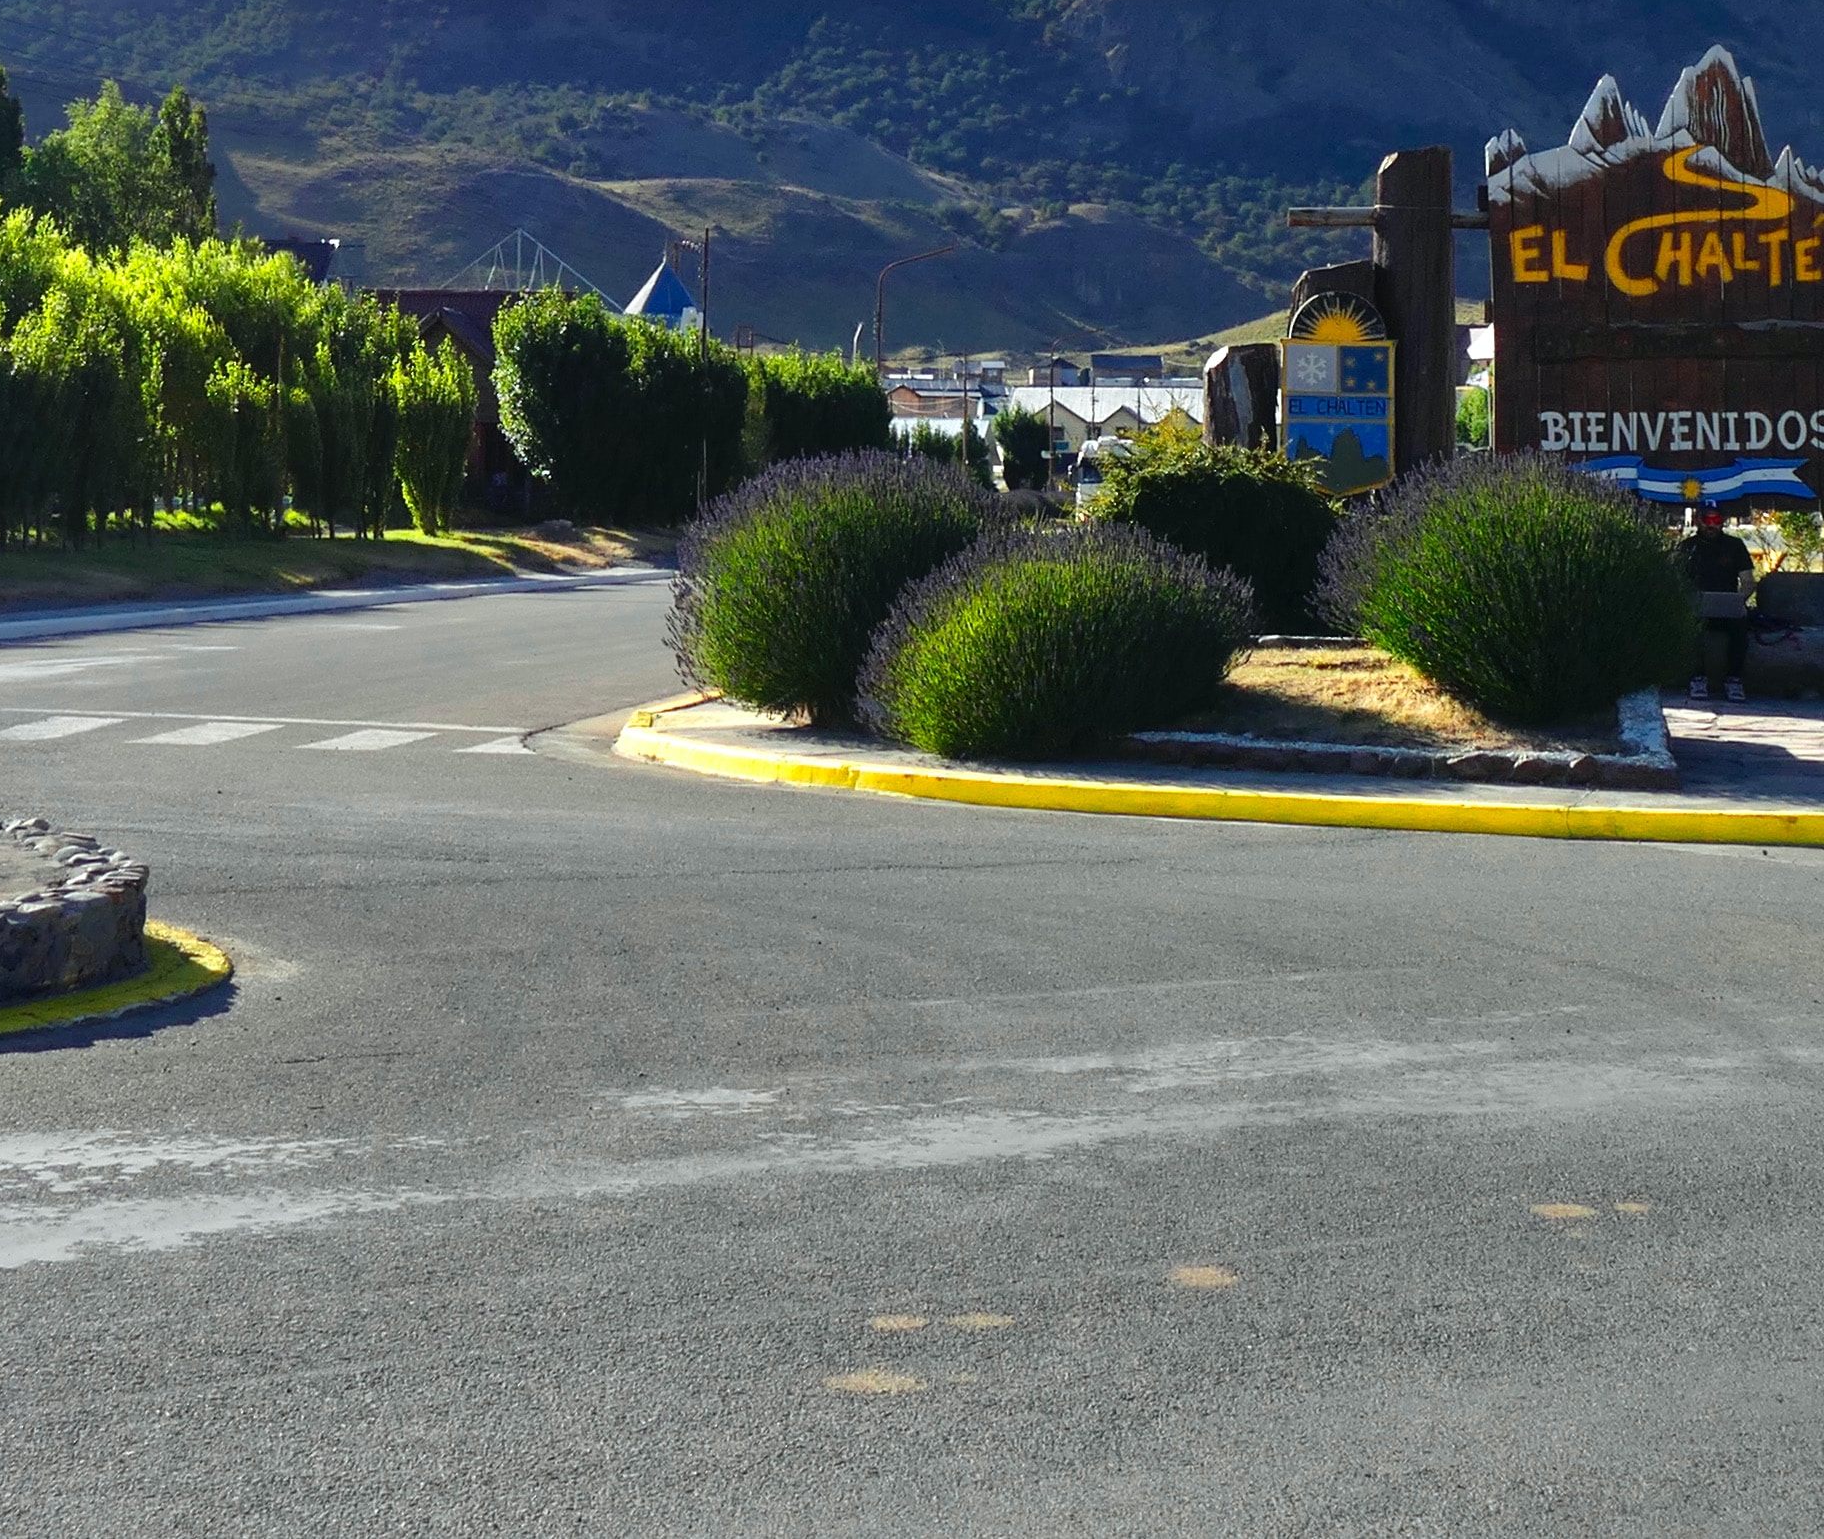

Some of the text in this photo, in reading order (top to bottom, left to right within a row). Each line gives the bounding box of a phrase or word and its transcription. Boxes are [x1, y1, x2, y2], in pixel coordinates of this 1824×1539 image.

[1509, 224, 1589, 283] EL
[1288, 398, 1386, 416] EL CHALTEN
